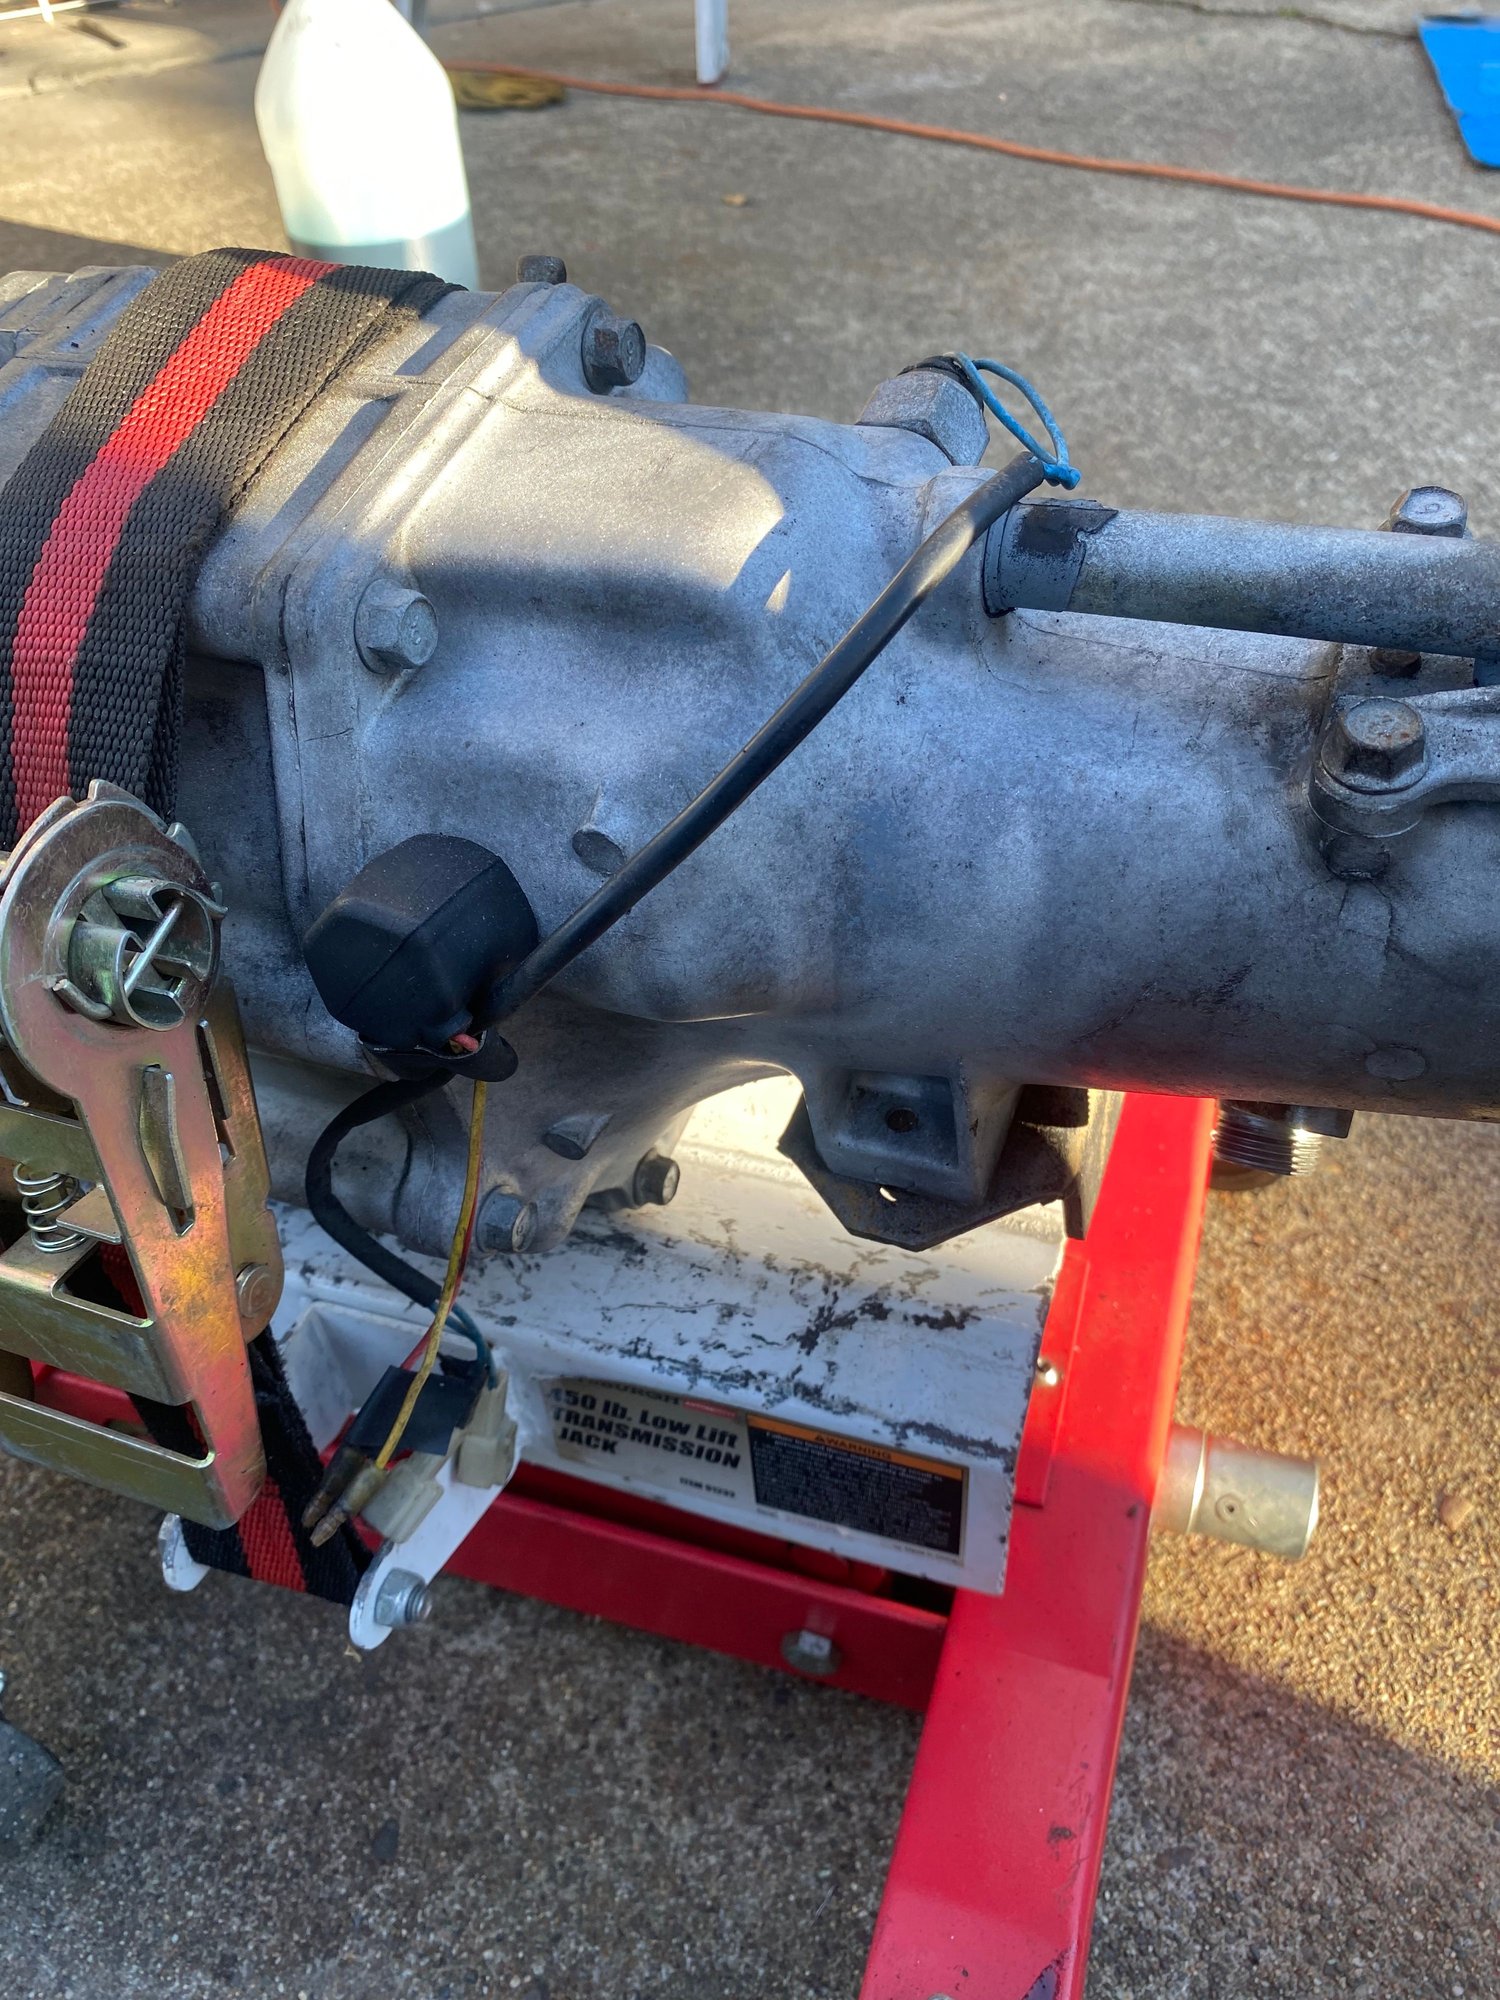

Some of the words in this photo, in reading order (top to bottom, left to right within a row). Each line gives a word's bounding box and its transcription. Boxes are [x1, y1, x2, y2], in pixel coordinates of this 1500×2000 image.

[553, 1406, 741, 1470] TRANSMISSION
[558, 1427, 619, 1455] JACK
[639, 1409, 691, 1436] Low
[695, 1424, 738, 1448] Lift
[824, 1437, 892, 1461] WARNING
